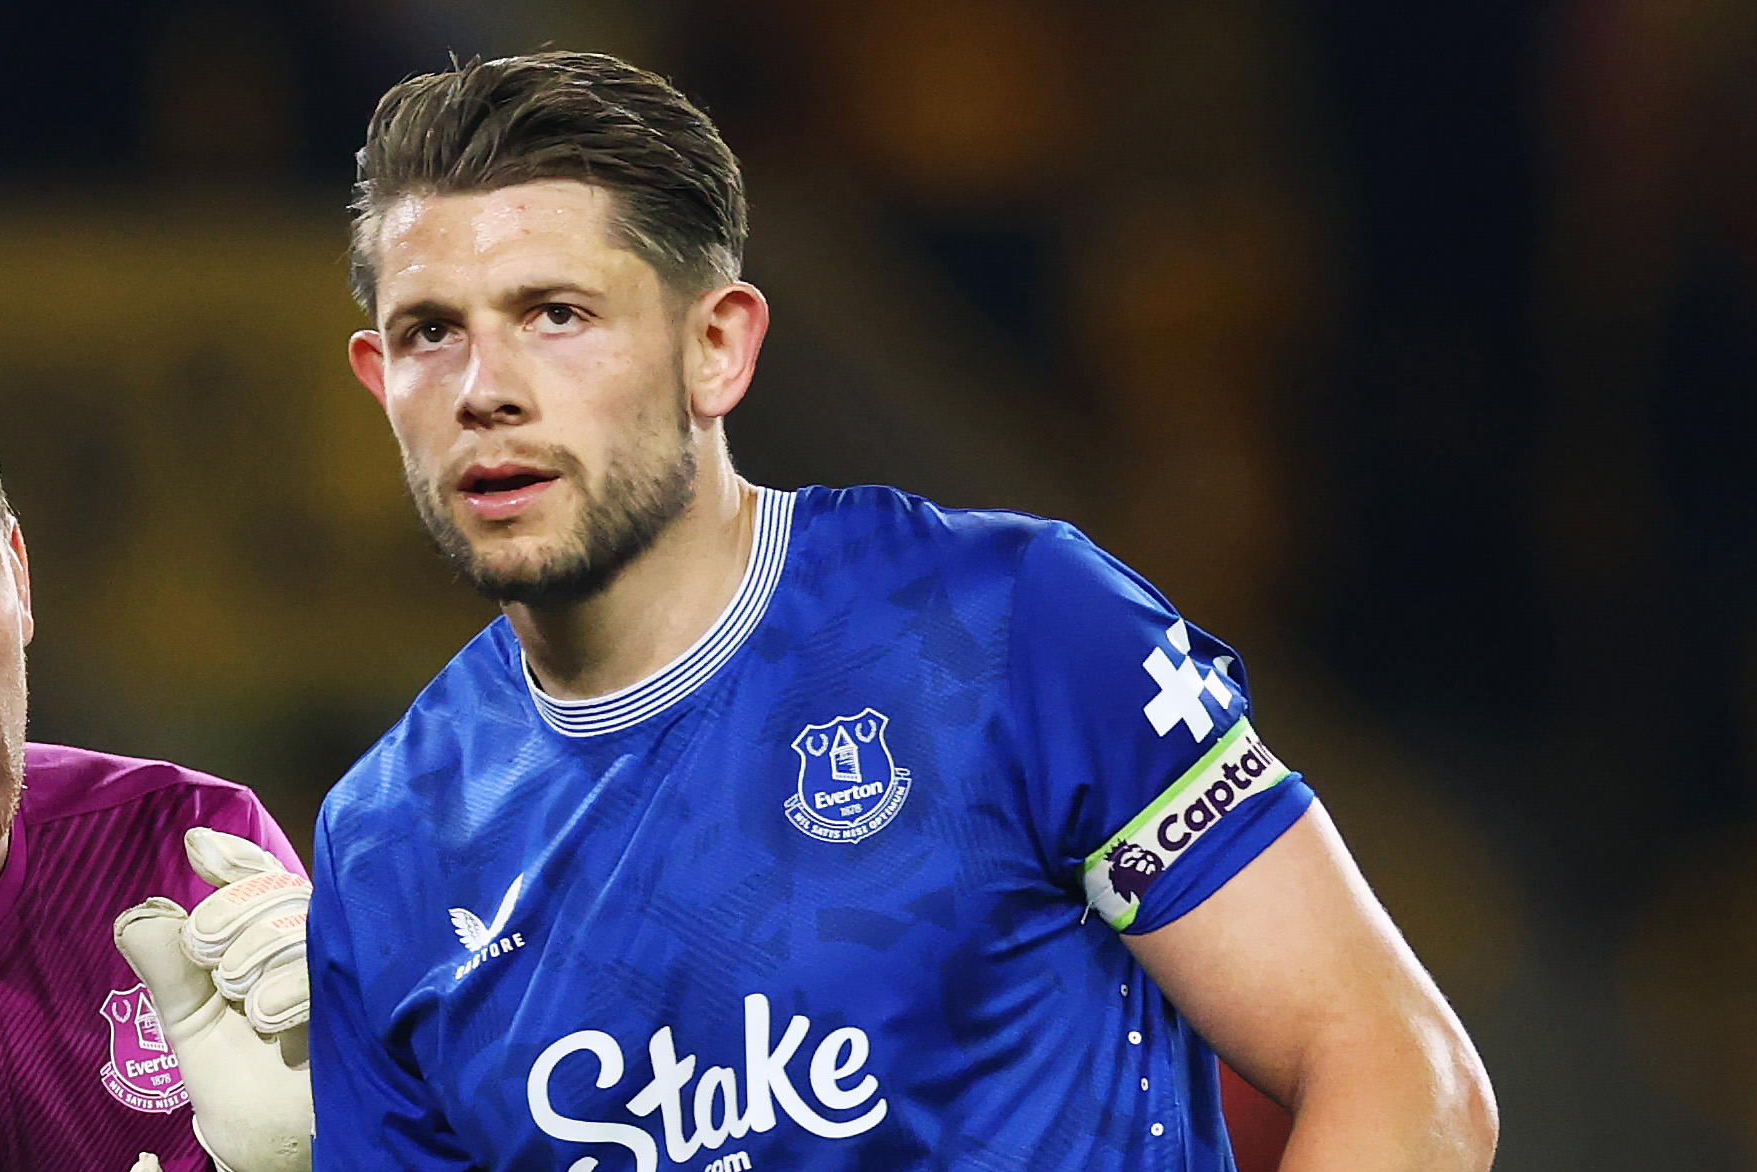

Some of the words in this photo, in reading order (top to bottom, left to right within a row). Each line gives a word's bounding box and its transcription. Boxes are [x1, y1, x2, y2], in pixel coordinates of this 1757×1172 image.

[814, 781, 883, 809] Everton
[1157, 735, 1273, 852] Captai
[125, 1054, 179, 1078] Everto
[150, 1073, 172, 1086] 1878
[109, 1080, 124, 1098] NIL
[125, 1093, 153, 1108] SATIS
[156, 1095, 179, 1108] NISI
